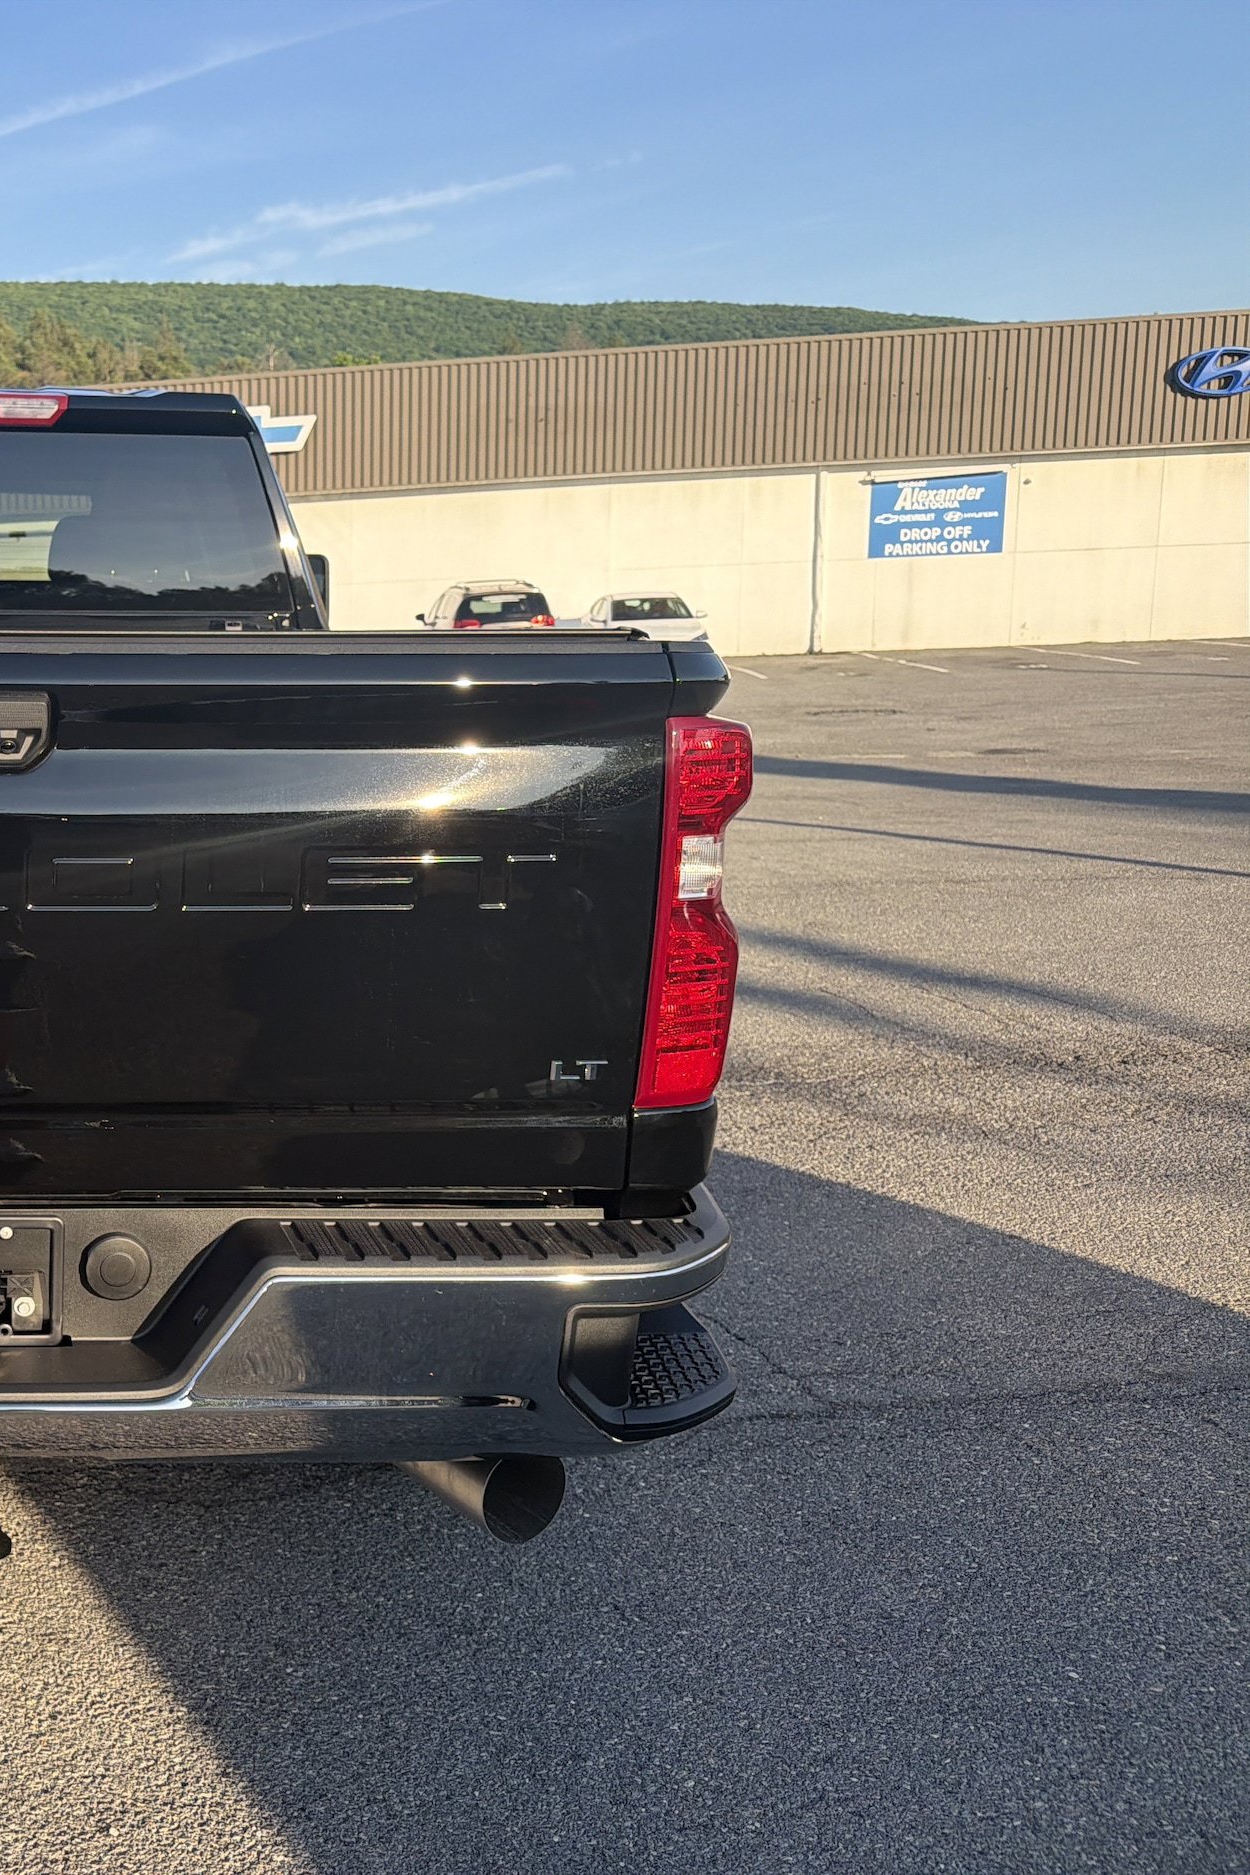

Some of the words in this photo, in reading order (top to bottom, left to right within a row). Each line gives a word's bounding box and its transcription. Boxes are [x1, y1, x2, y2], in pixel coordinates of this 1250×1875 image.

[894, 485, 986, 511] Alexander
[912, 501, 960, 510] ALTOONA
[900, 527, 941, 541] DROP
[943, 526, 972, 539] OFF
[884, 542, 948, 556] PARKING
[950, 540, 990, 553] ONLY
[550, 1060, 609, 1081] LT
